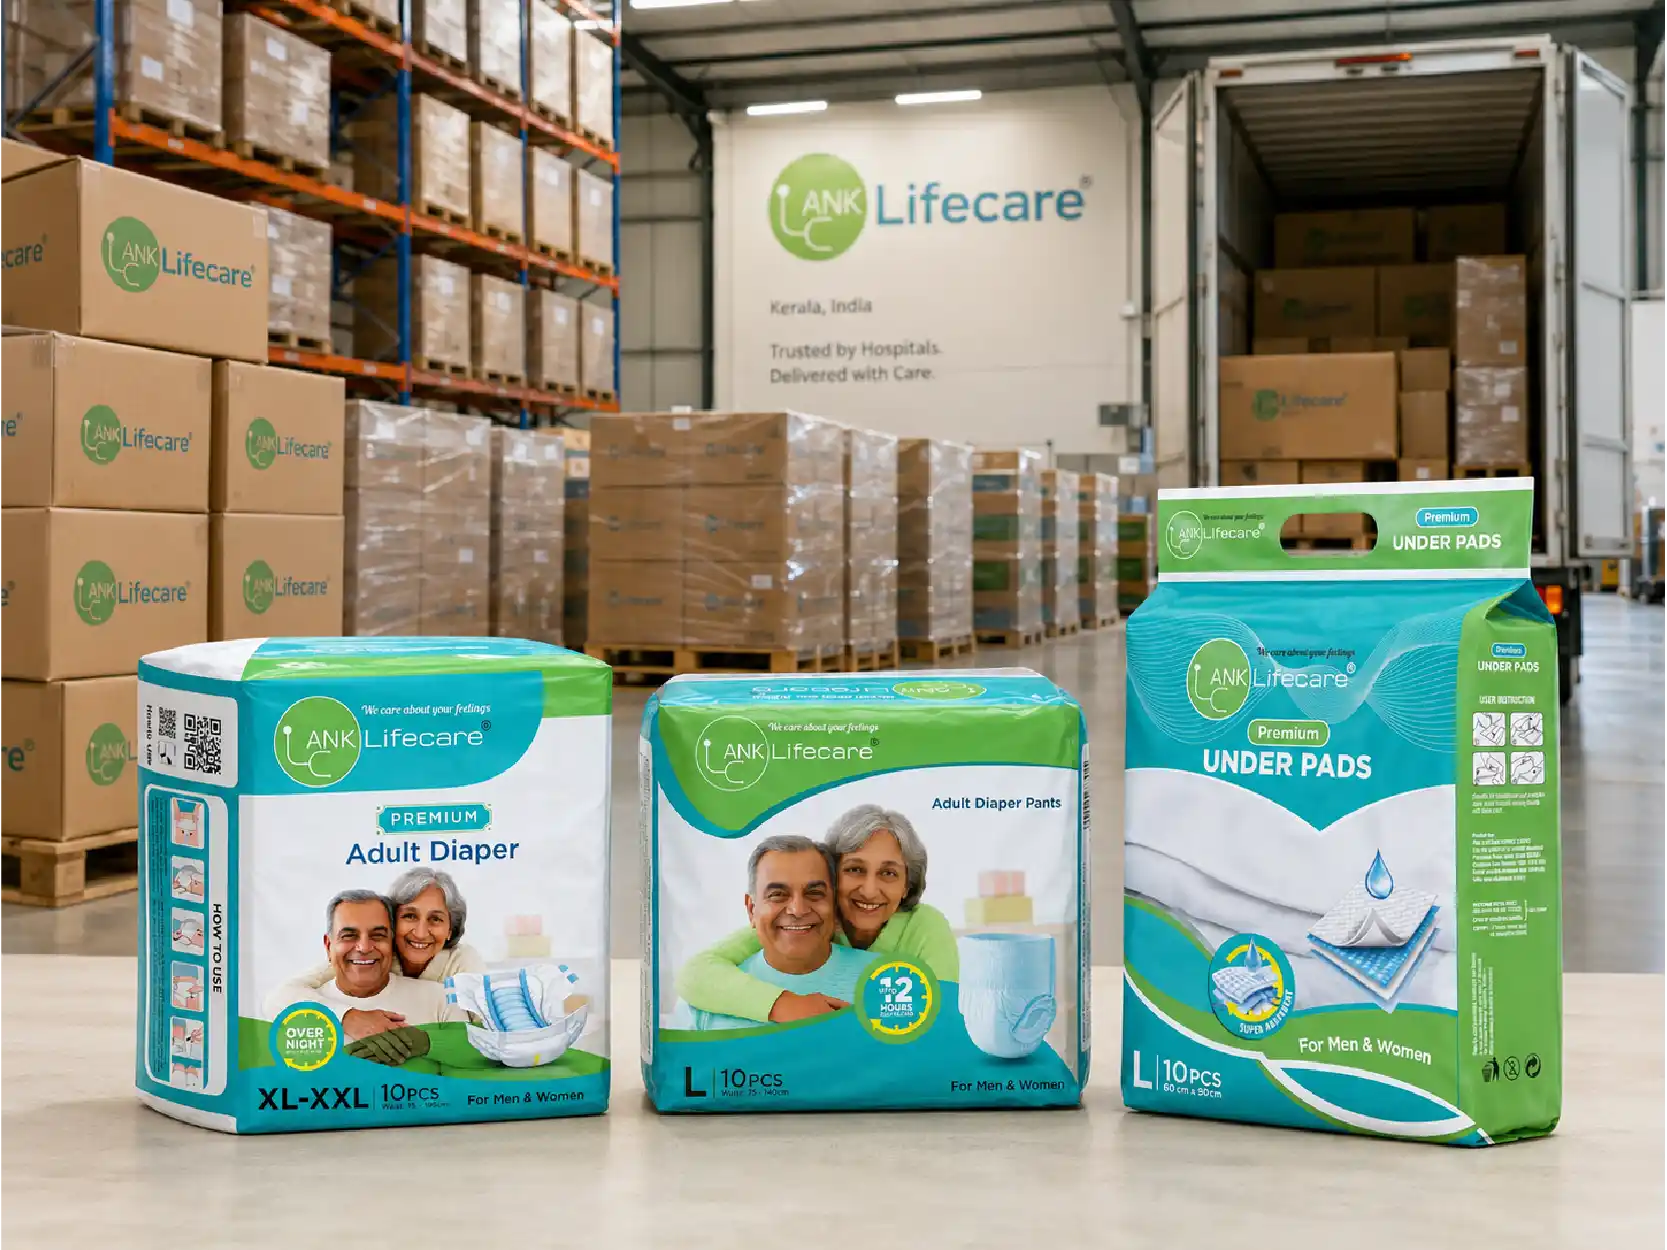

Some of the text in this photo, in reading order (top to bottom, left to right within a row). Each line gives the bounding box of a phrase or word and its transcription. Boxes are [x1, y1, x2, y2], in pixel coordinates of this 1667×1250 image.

[802, 182, 1085, 225] ANK Lifecare
[121, 240, 252, 288] ANK Lifecare
[770, 299, 872, 316] Kerala, India
[771, 343, 831, 359] Trusted
[836, 343, 857, 361] by
[771, 365, 935, 384] Delivered with Care.
[122, 427, 190, 452] Lifecare
[277, 436, 329, 459] Lifecare
[1424, 512, 1470, 522] Premium
[1179, 527, 1260, 539] ANK Lifecare
[1393, 534, 1502, 550] UNDER PADS
[118, 581, 187, 604] Lifecare
[274, 576, 328, 596] Lifecare
[1477, 661, 1540, 673] UNDER PADS
[1210, 667, 1348, 689] ANK Lifecare
[380, 706, 401, 715] care
[403, 704, 429, 715] about
[432, 705, 453, 716] your
[454, 703, 491, 716] feelings
[306, 728, 484, 750] ANK Lifecare
[1257, 725, 1319, 740] Premium
[724, 742, 873, 760] ANK Lifecare
[1203, 749, 1372, 780] UNDER PADS
[932, 797, 1062, 811] Adult Diaper Pants
[391, 810, 477, 826] PREMIUM
[346, 838, 520, 865] Adult Diaper
[212, 904, 222, 994] HOW TO USE
[880, 976, 913, 1003] 12
[880, 1003, 913, 1012] HOURS
[286, 1027, 324, 1038] OVER
[286, 1038, 325, 1050] NIGHT
[1299, 1036, 1432, 1066] For Men & Women
[1133, 1050, 1153, 1090] L
[685, 1066, 707, 1098] L
[951, 1079, 1065, 1093] For Men & Women
[258, 1087, 369, 1111] XL-XXL
[467, 1090, 584, 1106] For Men & Women
